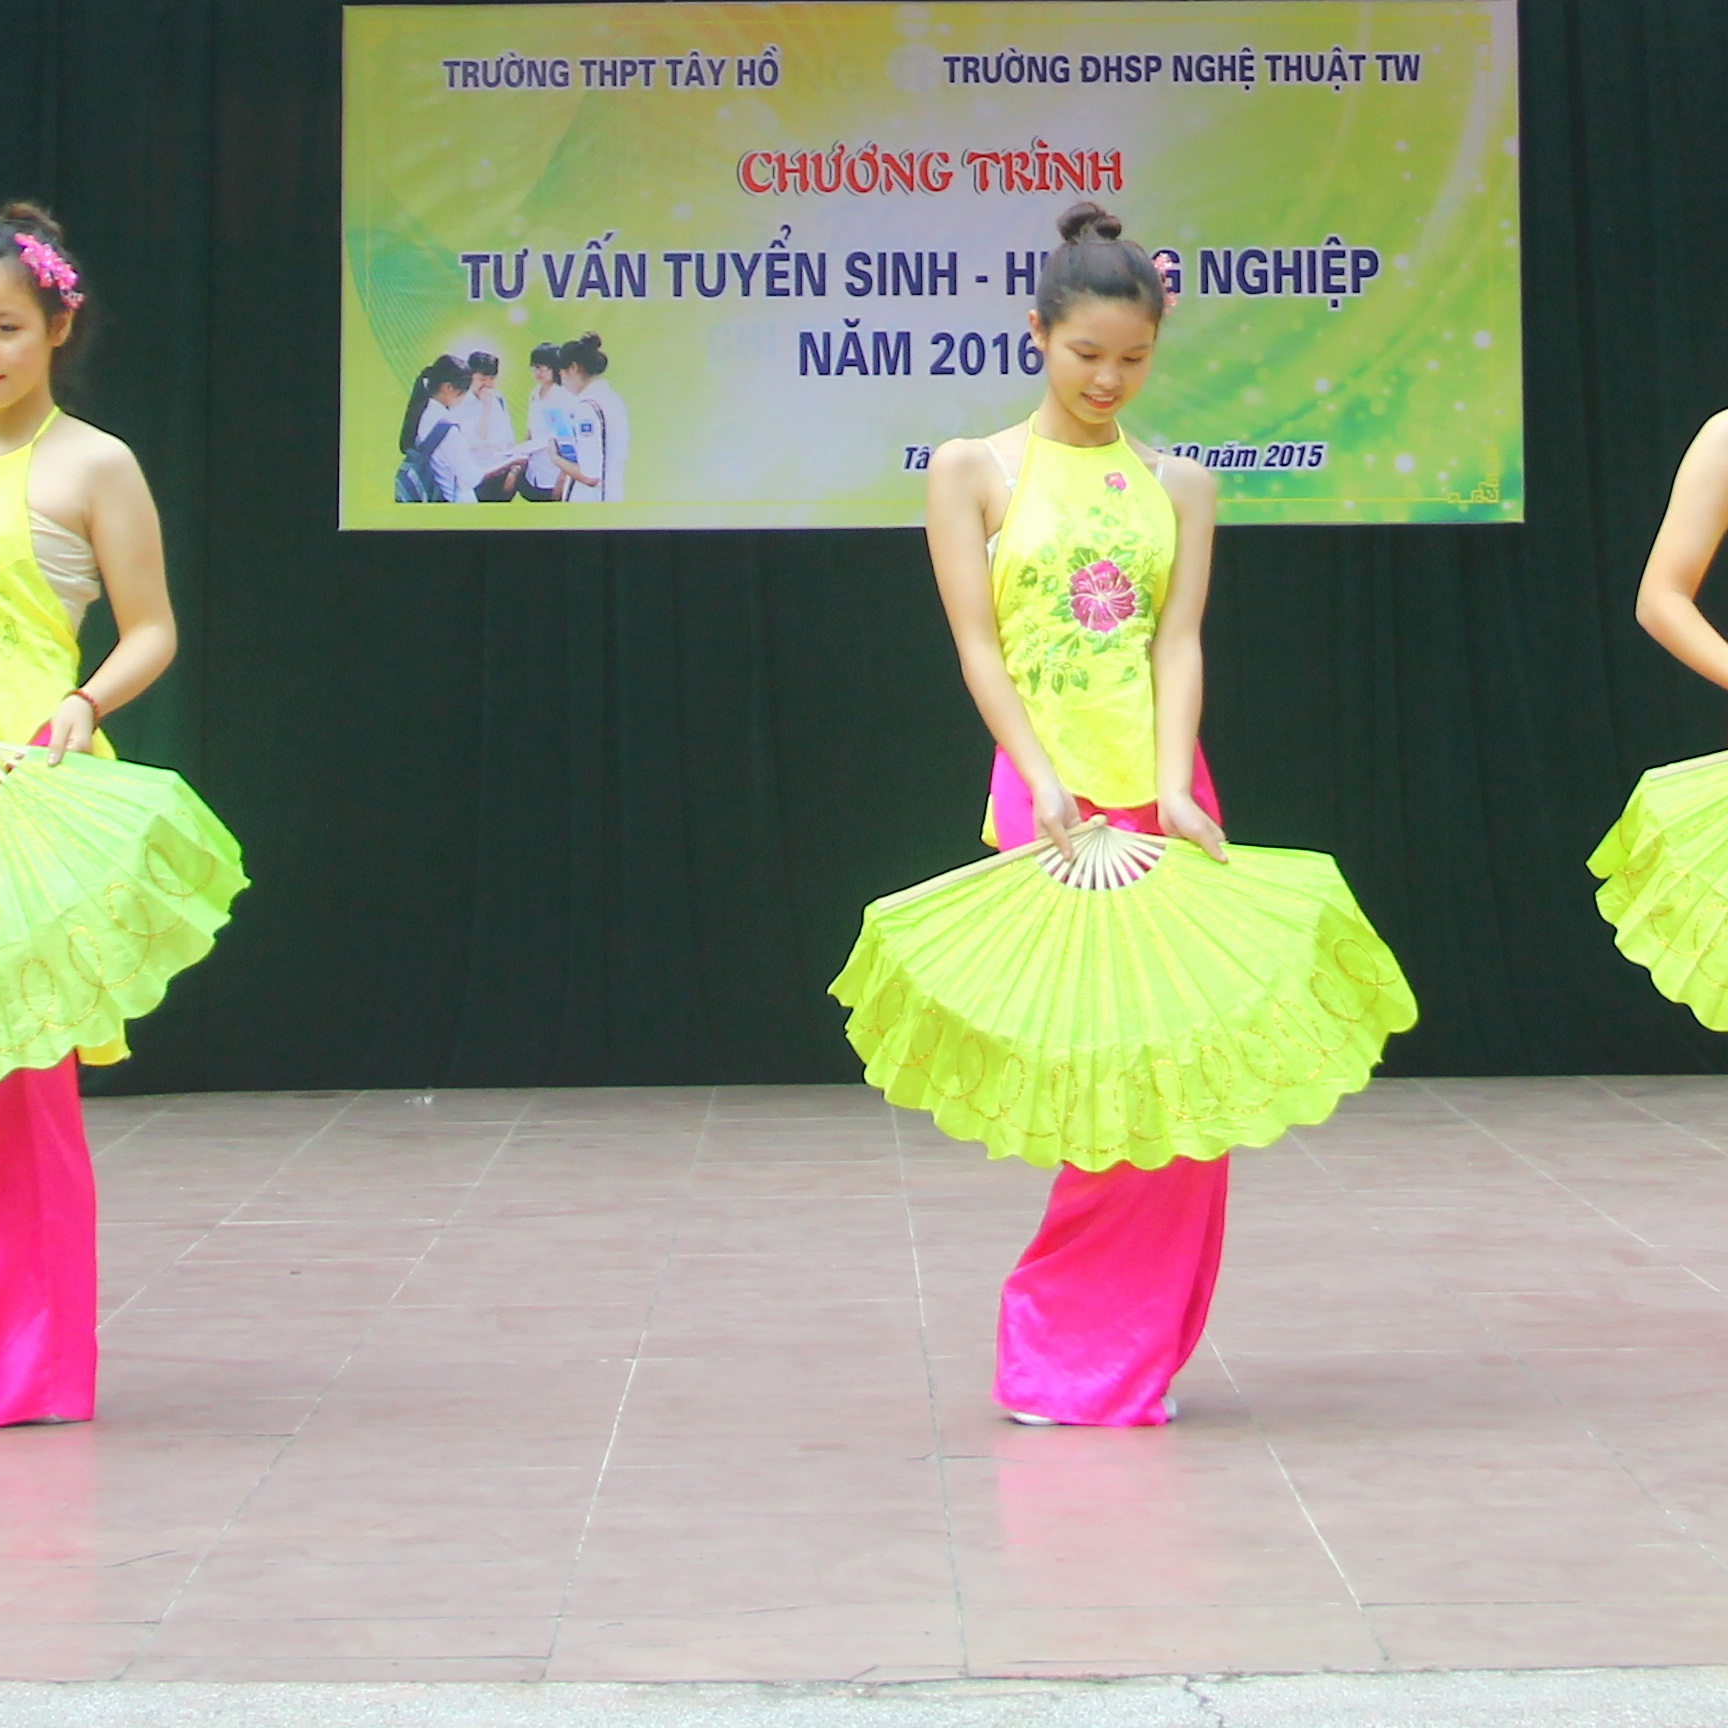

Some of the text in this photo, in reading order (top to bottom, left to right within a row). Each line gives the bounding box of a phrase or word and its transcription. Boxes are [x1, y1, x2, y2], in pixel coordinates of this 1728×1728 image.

[442, 46, 779, 88] TRƯỜNG THPT TÂY HỒ
[942, 46, 1421, 91] TRƯỜNG ĐHSP NGHỆ THUẬT TW
[739, 137, 1124, 195] CHƯƠNG TRÌNH
[461, 248, 529, 299] TƯ
[542, 231, 647, 298] VẤN
[663, 224, 827, 298] TUYỂN
[844, 250, 958, 297] SINH
[1200, 236, 1379, 308] NGHIỆP
[798, 318, 912, 376] NĂM
[929, 331, 1045, 376] 2016
[1205, 443, 1258, 468] năm
[1264, 444, 1324, 468] 2015
